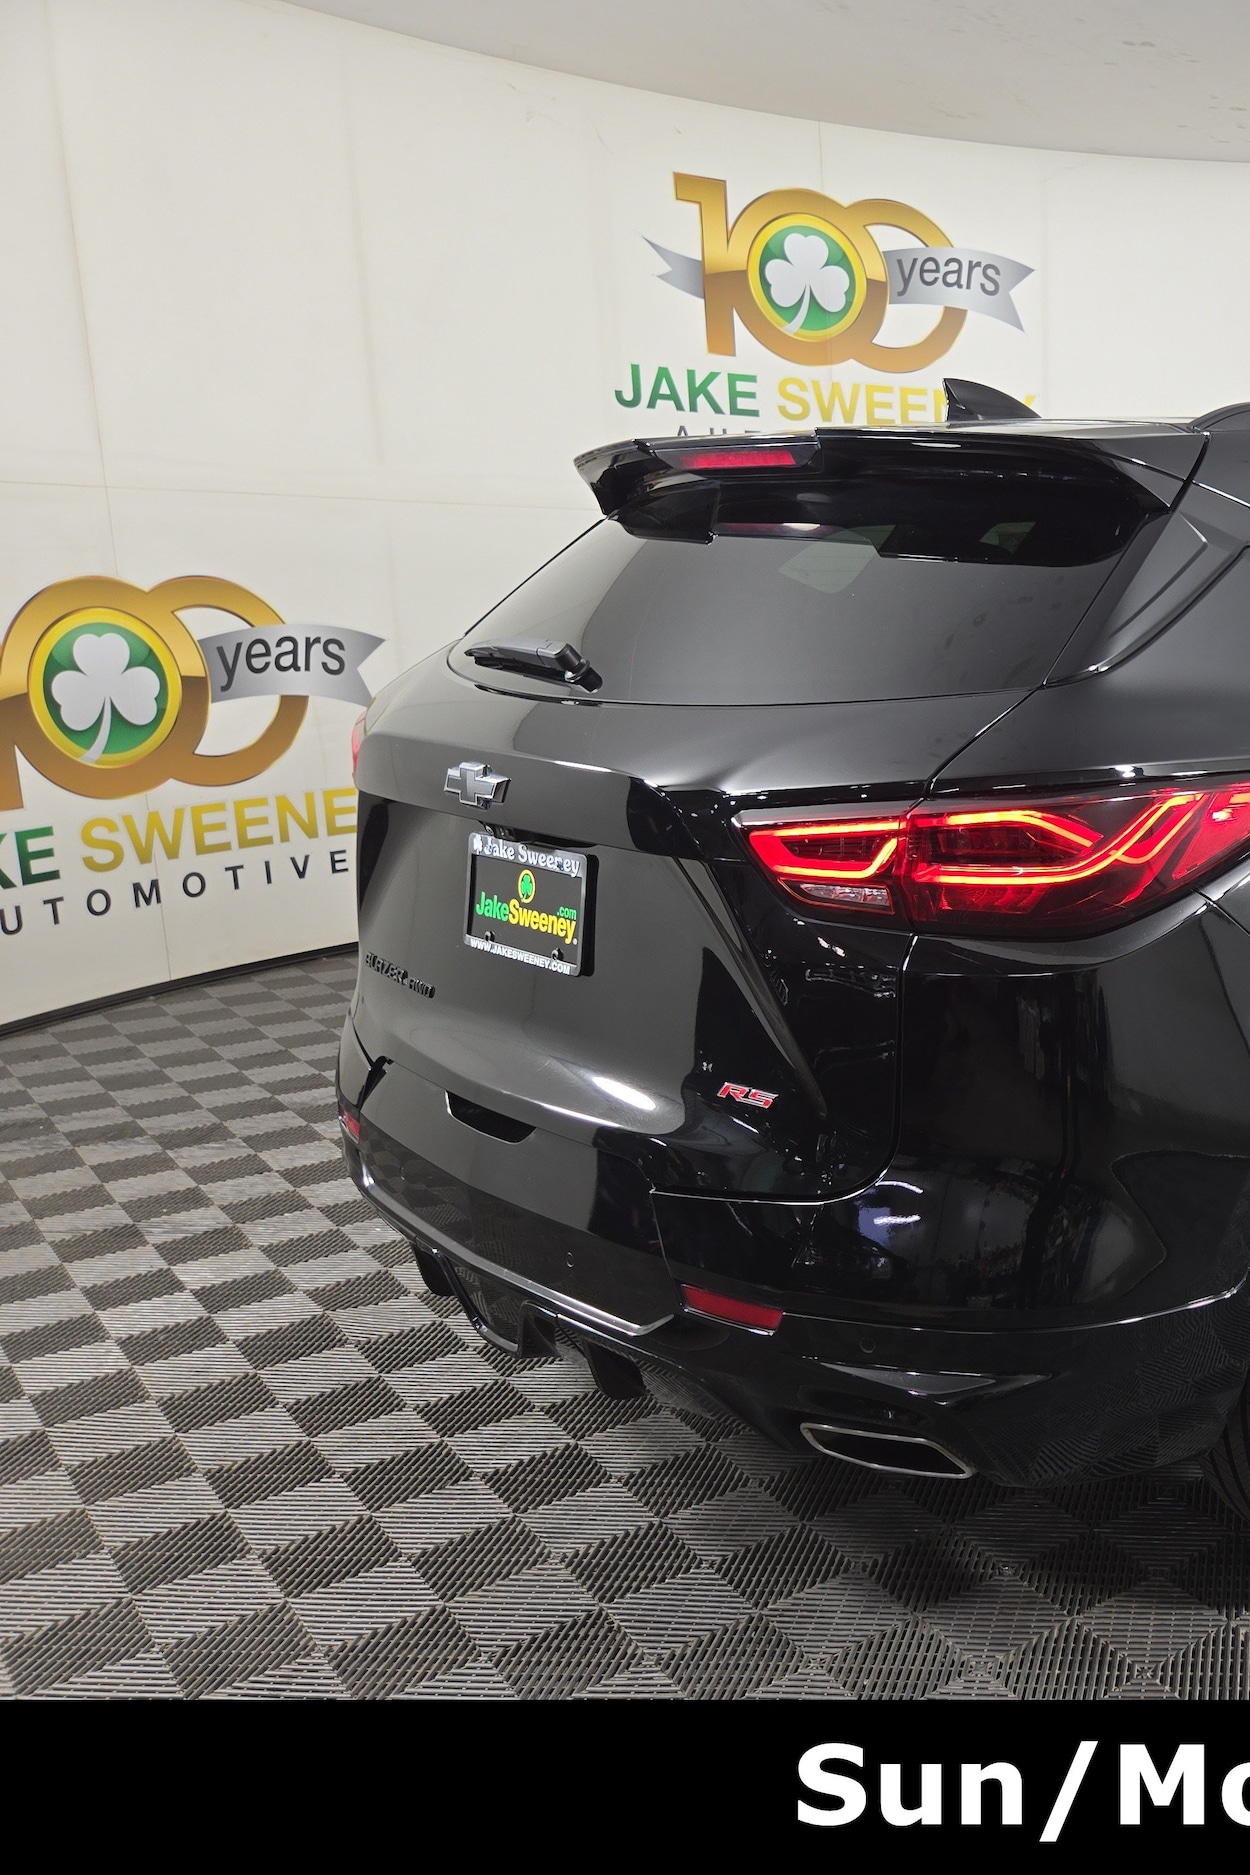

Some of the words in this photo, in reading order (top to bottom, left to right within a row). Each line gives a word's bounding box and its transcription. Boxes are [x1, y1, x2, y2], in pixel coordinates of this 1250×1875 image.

[672, 171, 968, 374] 100
[896, 252, 1002, 297] years
[614, 362, 760, 418] JAKE
[215, 634, 347, 691] years
[80, 787, 358, 873] SWEENE
[484, 838, 515, 861] Jake
[518, 843, 581, 878] Sweeney
[0, 849, 349, 936] UTOMOTIVE
[470, 937, 571, 976] WWW.JAKESWEENEY.COM
[717, 1082, 779, 1109] RS
